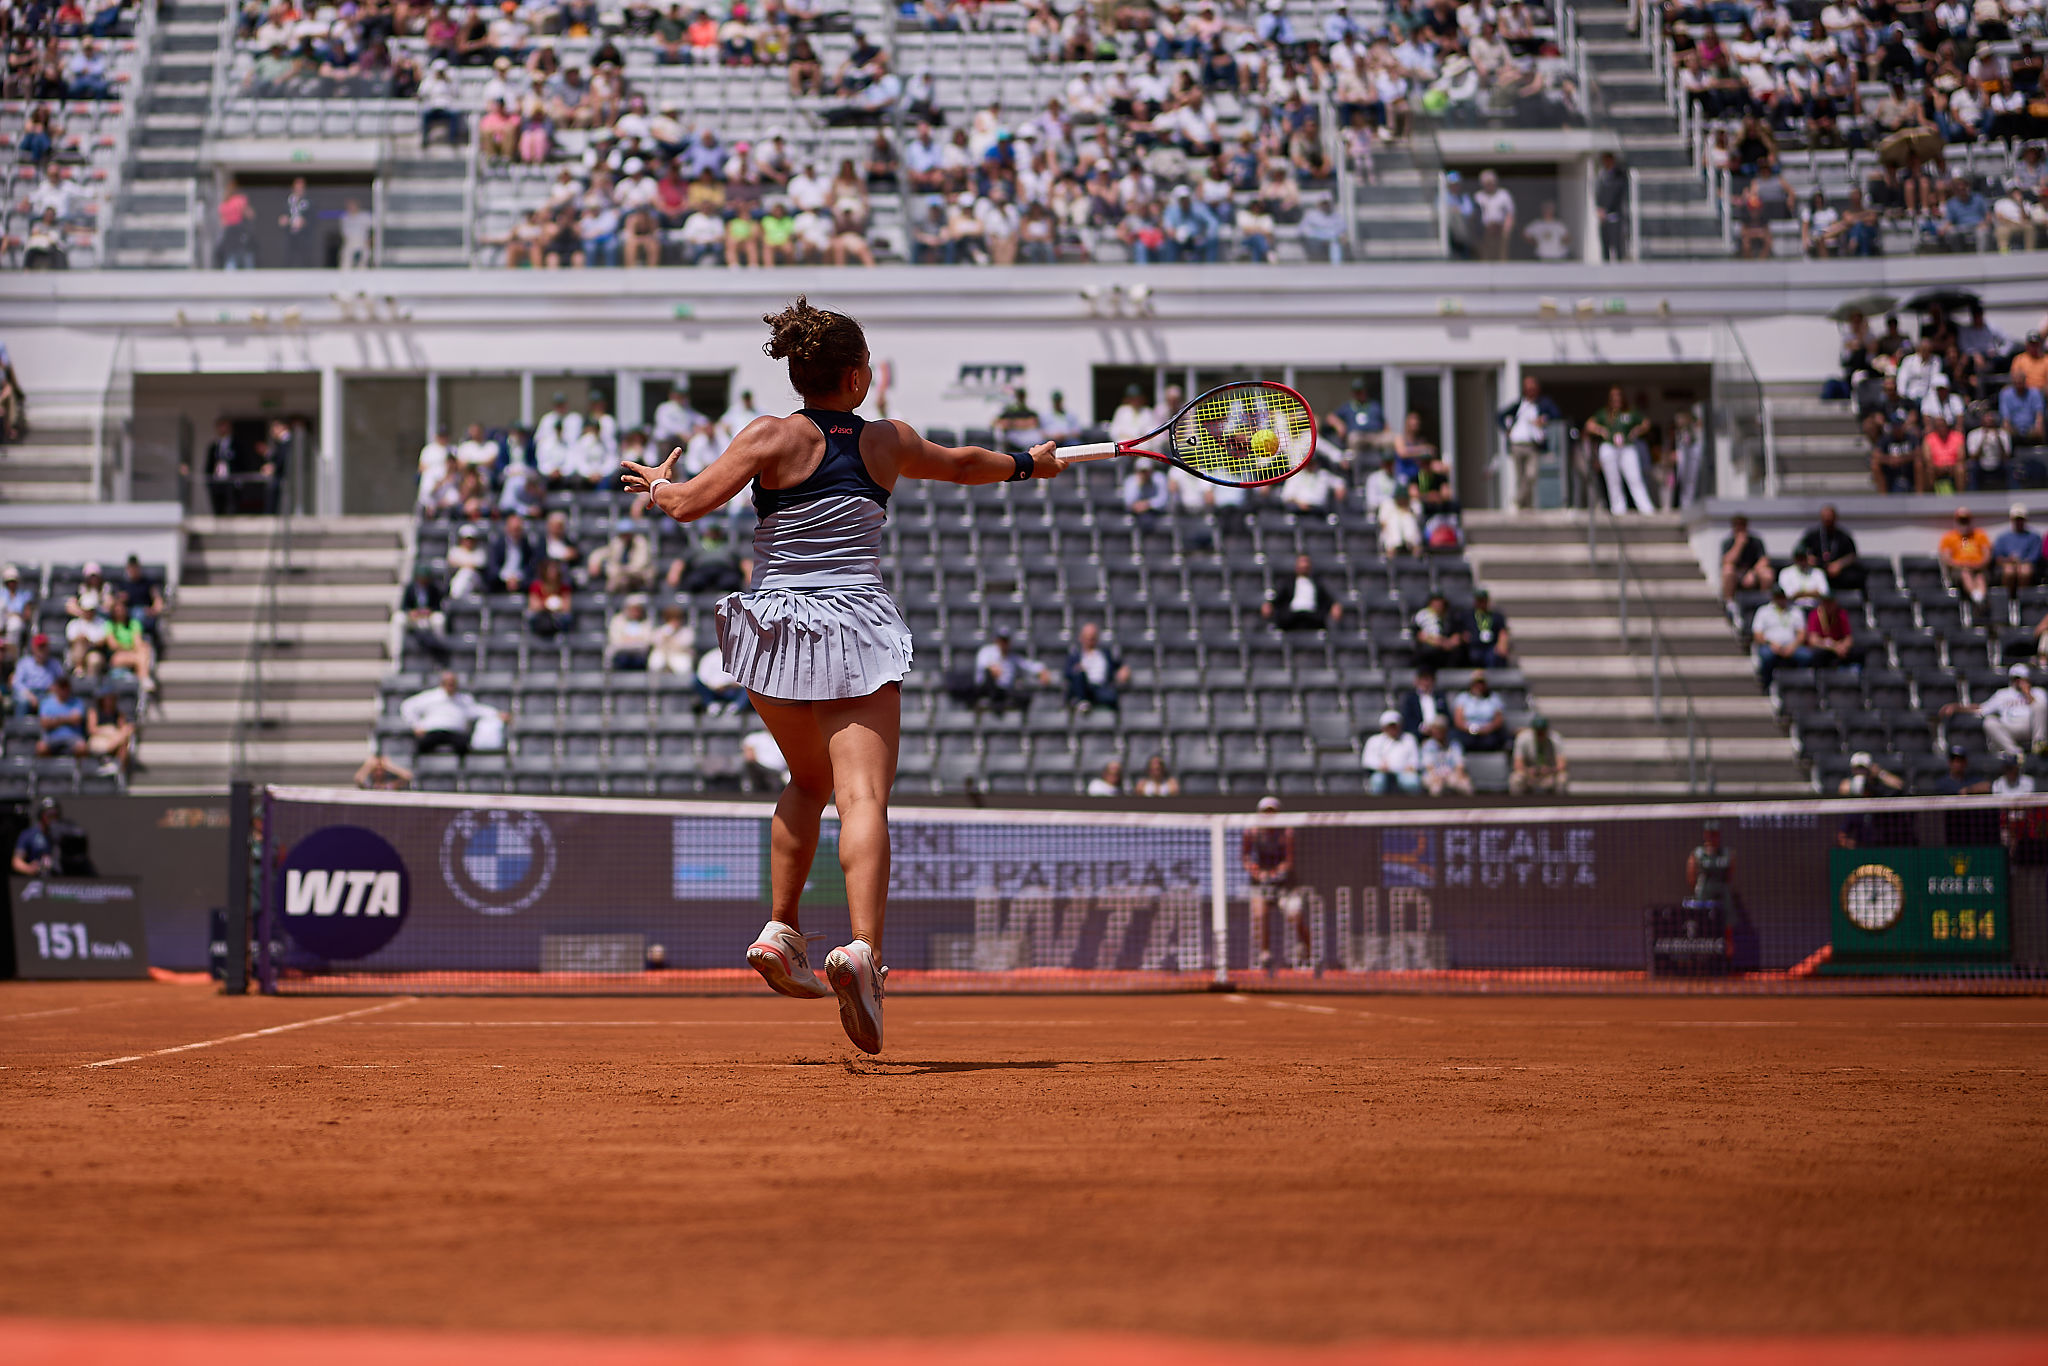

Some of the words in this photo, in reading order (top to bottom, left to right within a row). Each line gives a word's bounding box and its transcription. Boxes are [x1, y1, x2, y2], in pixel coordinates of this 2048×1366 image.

[1444, 828, 1596, 863] REALE
[285, 869, 400, 917] WTA
[992, 860, 1199, 892] PARIBAS
[1445, 863, 1596, 888] MUTUA
[32, 921, 89, 959] 151
